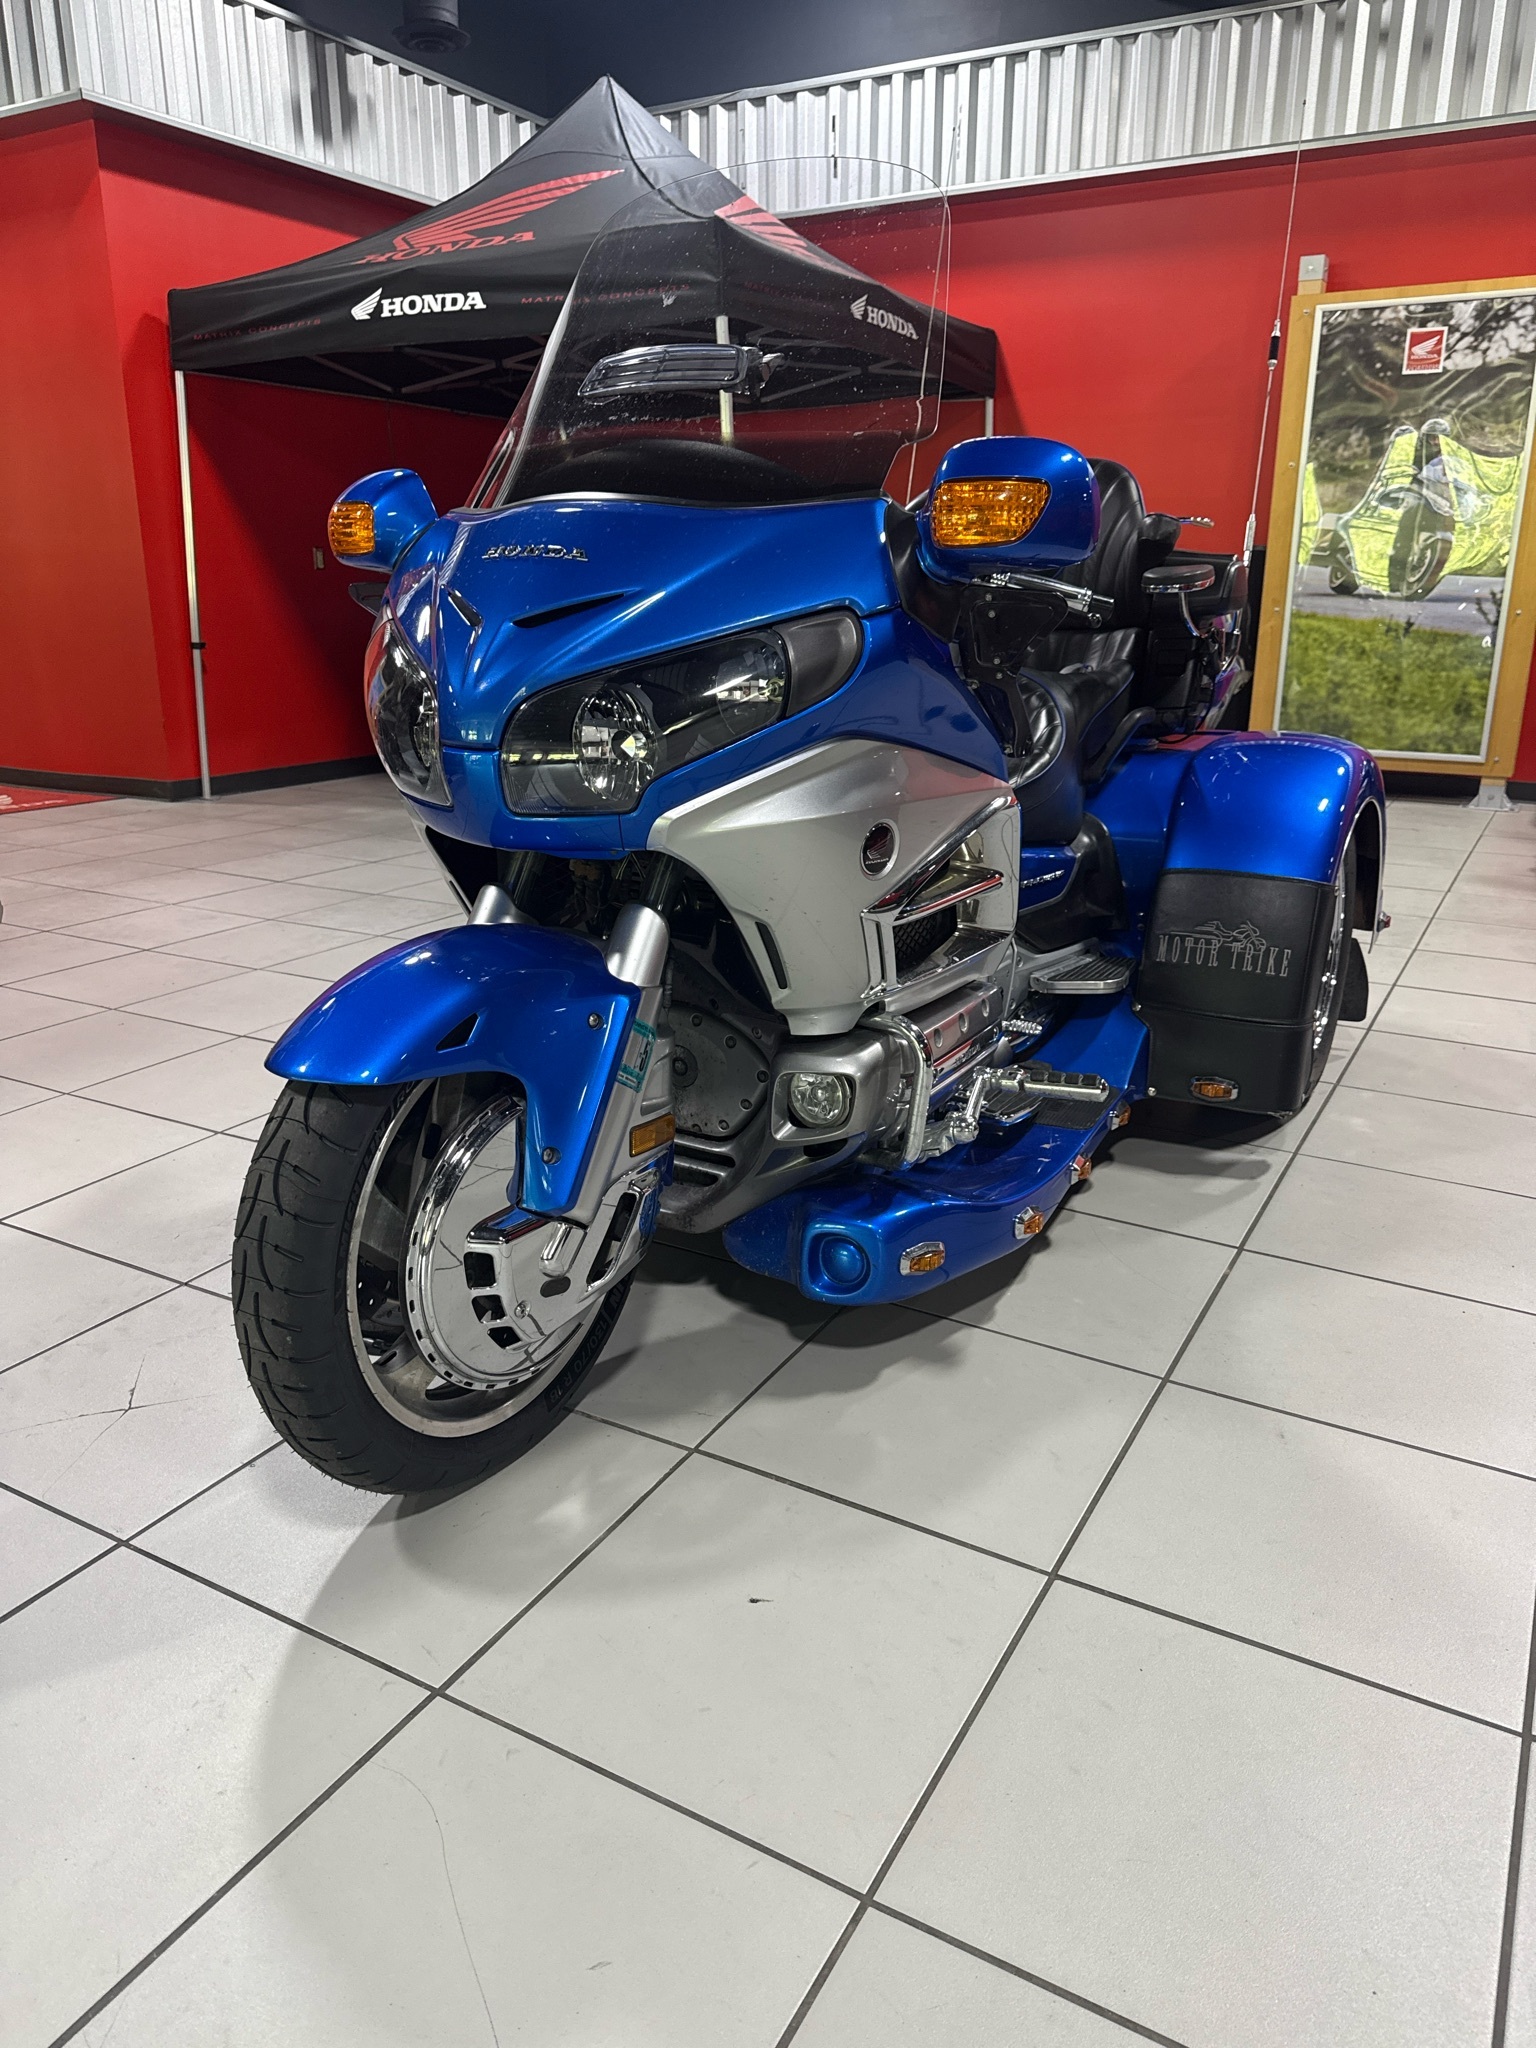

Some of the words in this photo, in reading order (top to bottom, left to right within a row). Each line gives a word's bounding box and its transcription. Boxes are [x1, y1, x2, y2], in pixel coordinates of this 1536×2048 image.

[354, 231, 536, 265] HONDA
[380, 291, 487, 318] HONDA
[866, 305, 919, 340] HONDA
[482, 544, 588, 561] HONDA
[1156, 935, 1218, 967] MOTOR
[1230, 942, 1291, 977] TRIKE
